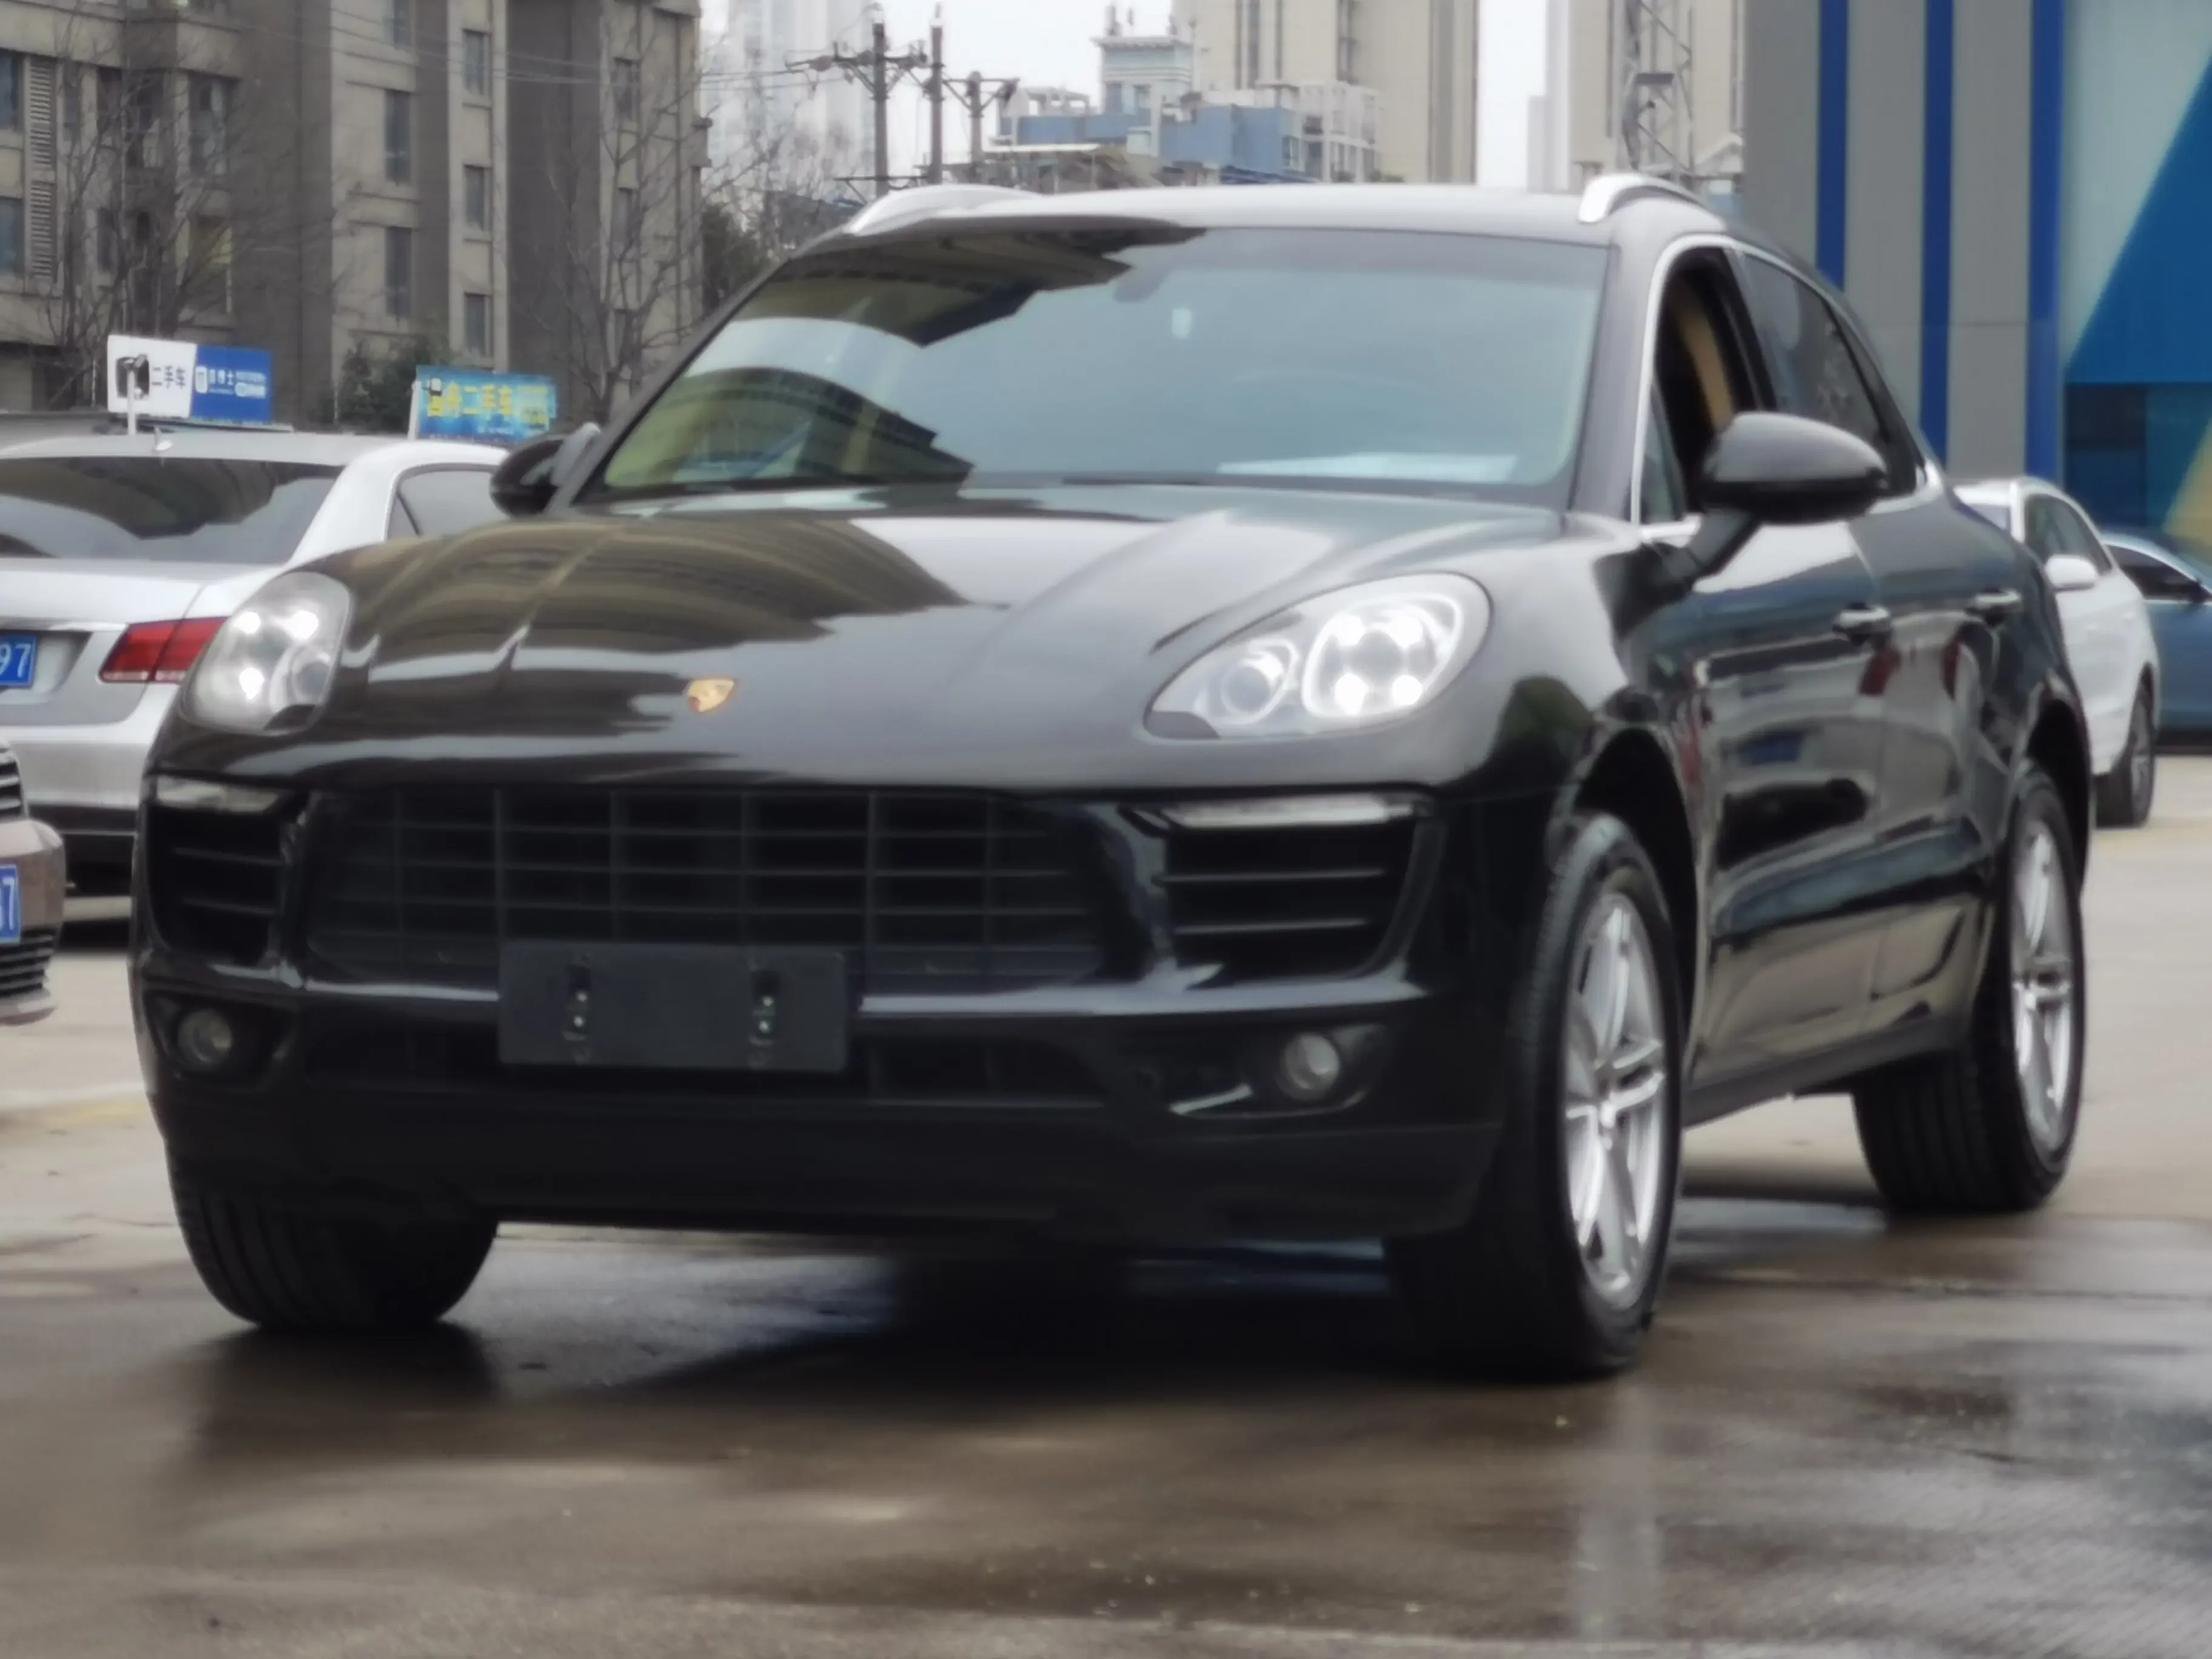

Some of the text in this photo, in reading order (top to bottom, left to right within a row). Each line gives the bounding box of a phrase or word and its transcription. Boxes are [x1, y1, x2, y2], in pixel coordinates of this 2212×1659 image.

[152, 365, 186, 390] 二手车
[0, 643, 31, 679] 97
[0, 877, 15, 931] 7
